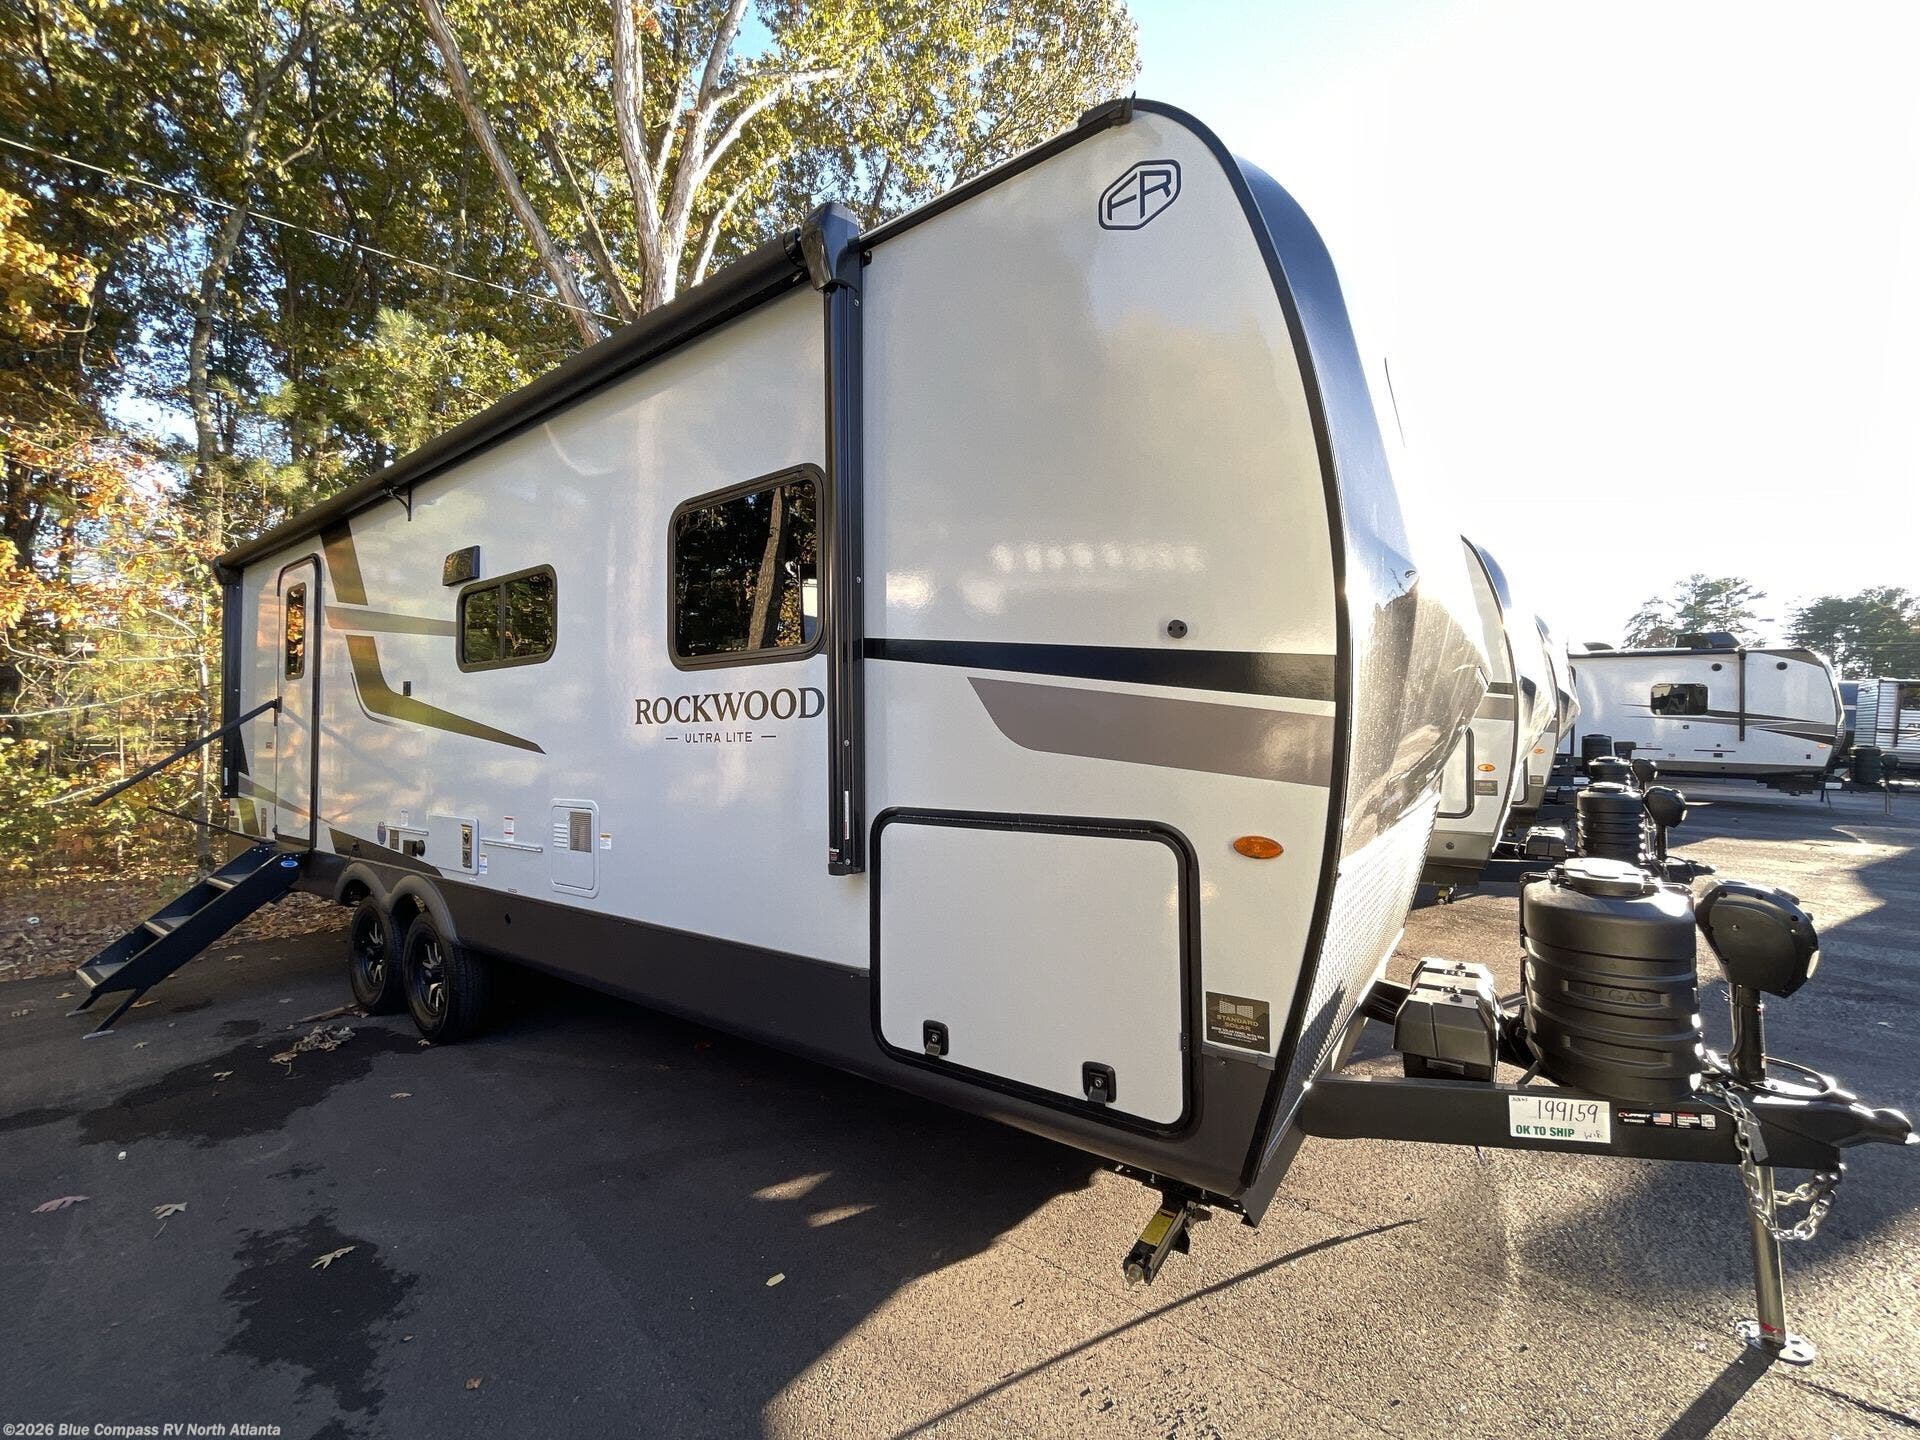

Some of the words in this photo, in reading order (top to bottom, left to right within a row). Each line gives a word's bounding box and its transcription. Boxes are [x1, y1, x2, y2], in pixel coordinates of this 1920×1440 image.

[635, 687, 825, 725] ROCKWOOD
[684, 732, 721, 744] ULTRA
[726, 731, 753, 743] LITE
[1584, 983, 1602, 997] LP
[1608, 989, 1649, 1004] GAS
[1216, 1014, 1259, 1027] STANDARD
[1224, 1021, 1252, 1032] SOLAR
[1538, 1099, 1599, 1124] 199159
[1515, 1124, 1531, 1135] OK
[1533, 1126, 1547, 1136] TO
[1549, 1127, 1575, 1138] SHIP
